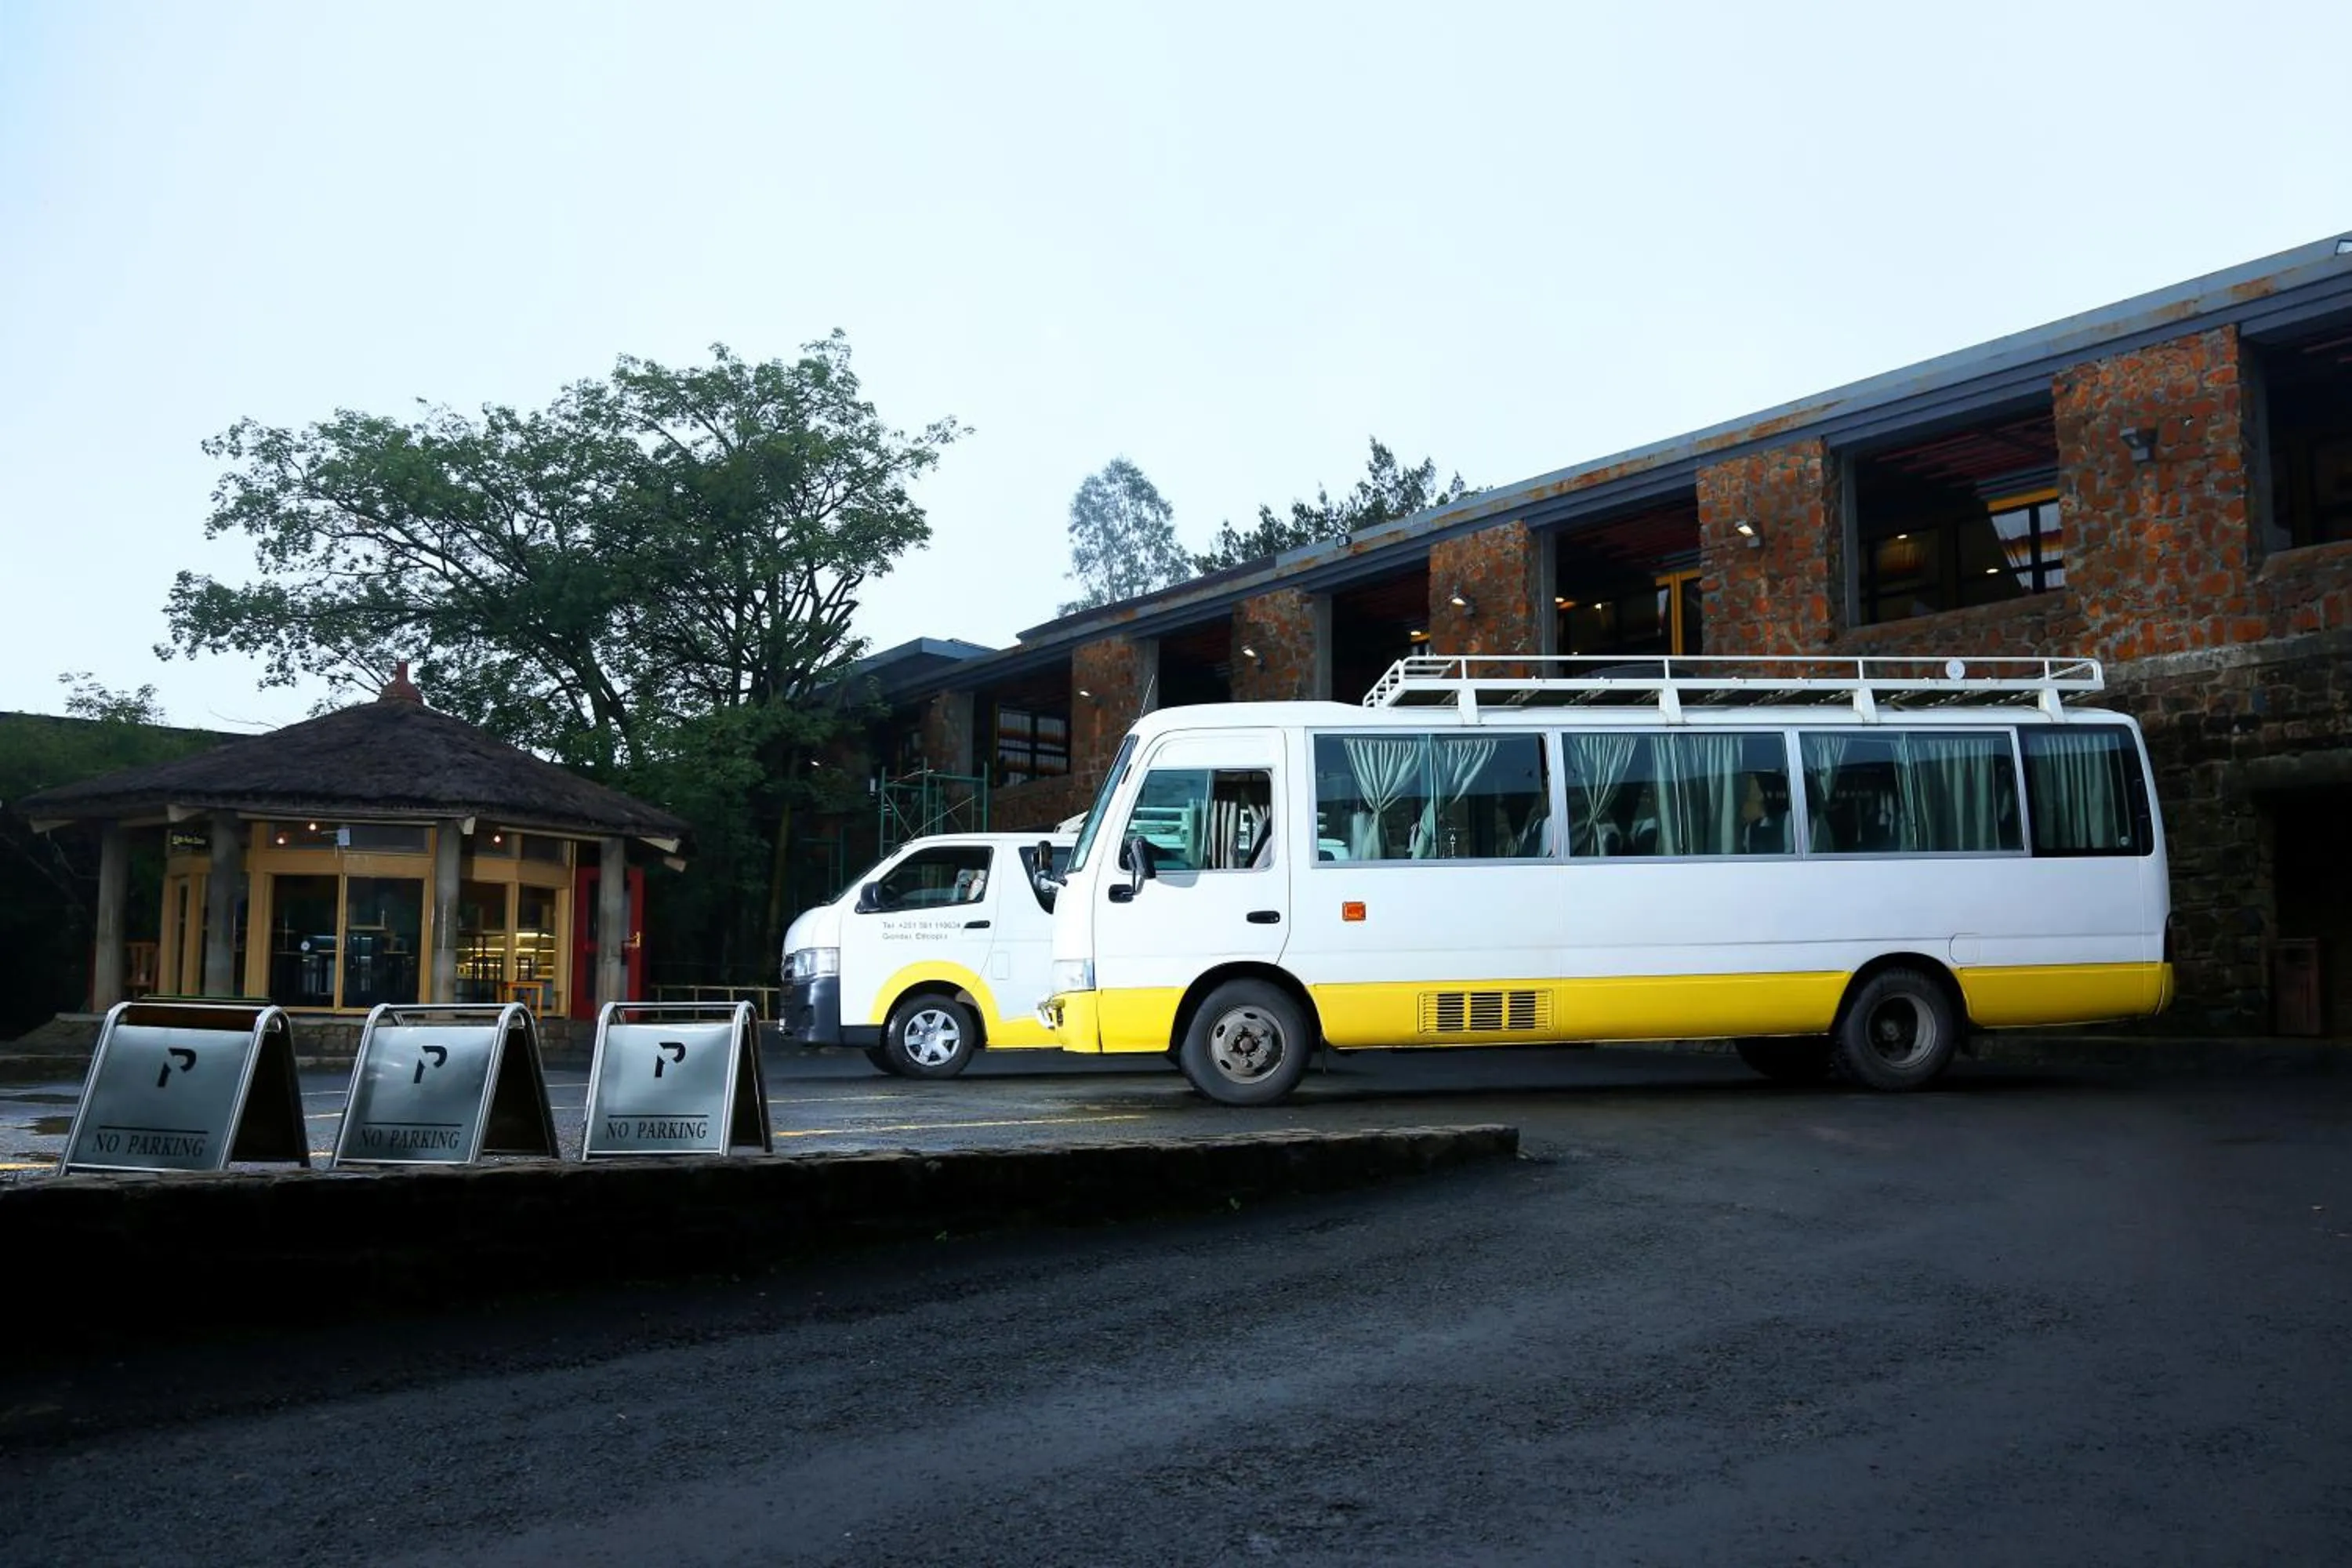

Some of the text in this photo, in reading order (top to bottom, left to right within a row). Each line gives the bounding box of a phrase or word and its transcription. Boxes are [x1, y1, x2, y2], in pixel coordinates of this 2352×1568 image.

[359, 1128, 460, 1149] NO PARKING
[606, 1122, 708, 1139] NO PARKING
[92, 1134, 206, 1157] NO PARKING
